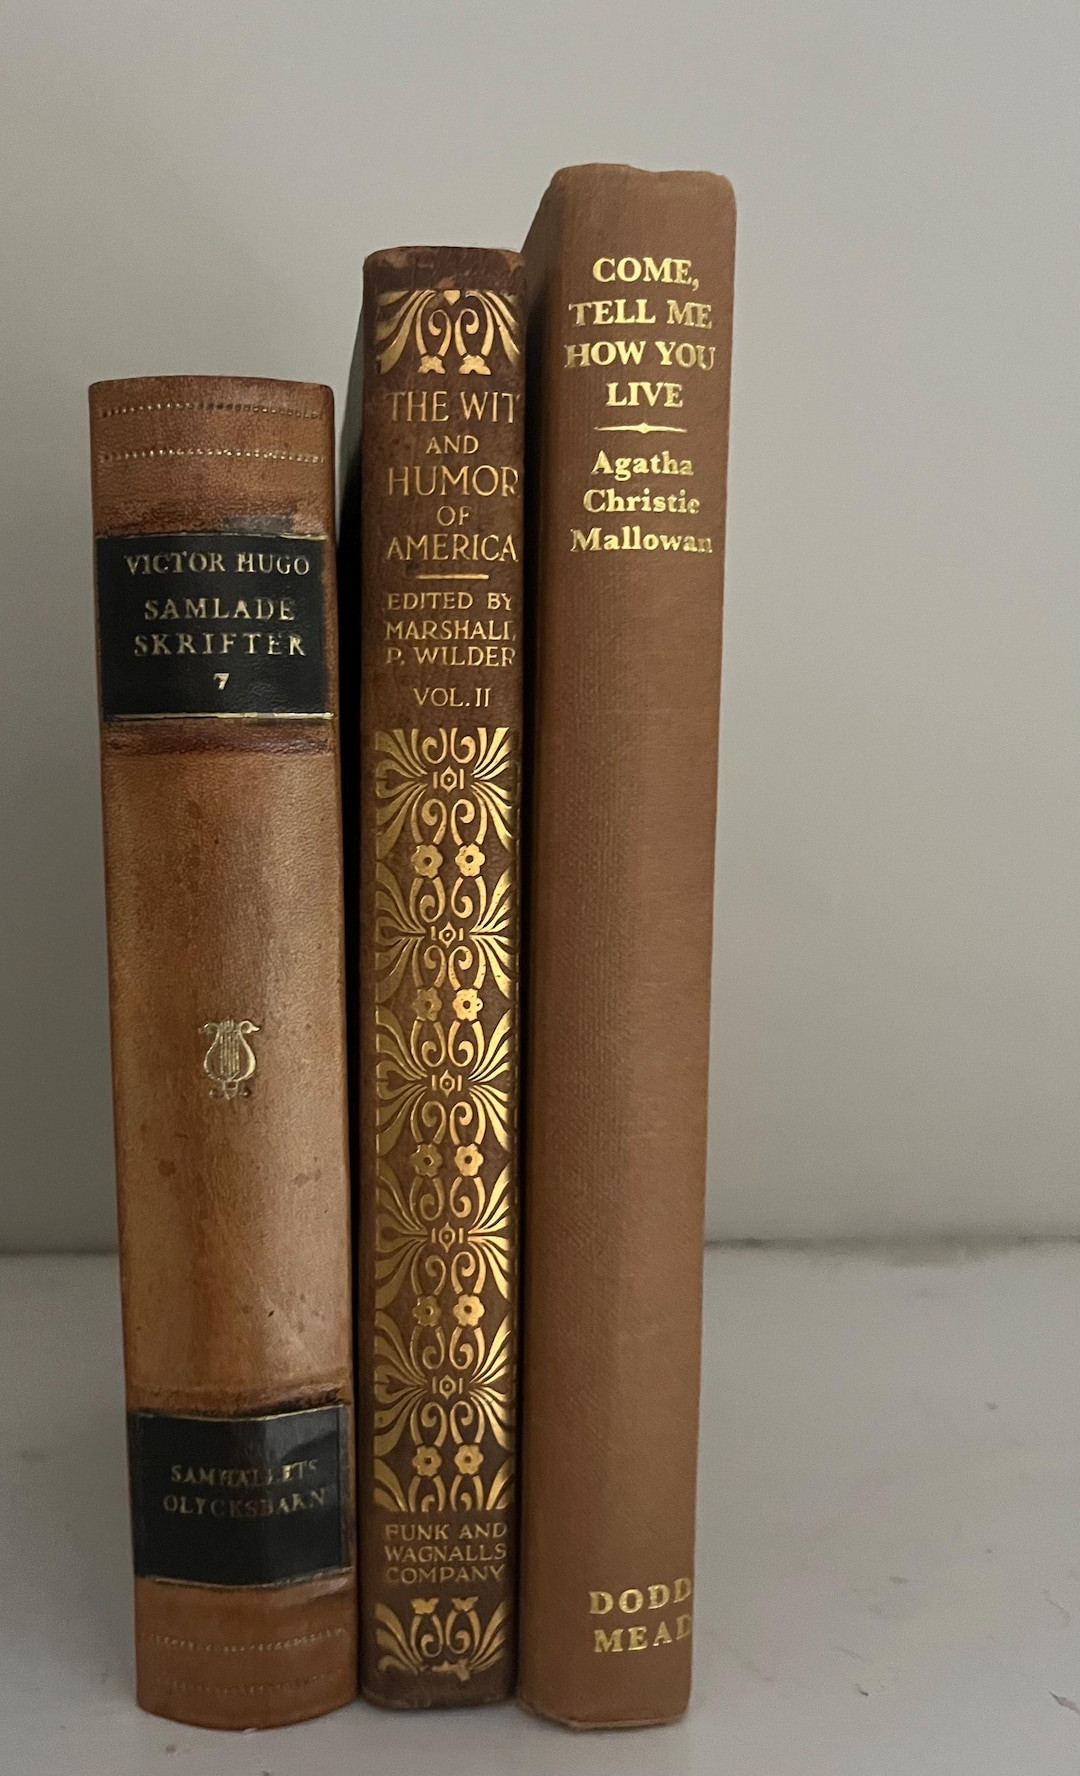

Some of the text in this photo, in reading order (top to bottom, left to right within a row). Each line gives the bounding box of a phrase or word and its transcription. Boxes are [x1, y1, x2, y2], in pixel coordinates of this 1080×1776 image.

[592, 257, 700, 291] COME,
[568, 298, 713, 329] TELL ME
[563, 340, 716, 371] HOW YOU
[388, 390, 521, 424] THE WIT
[605, 381, 684, 408] LIVE
[425, 434, 479, 454] AND
[591, 450, 694, 482] Agatha
[388, 464, 520, 497] HUMOR
[583, 487, 701, 514] Christie
[436, 505, 472, 527] OF
[386, 533, 519, 562] AMERICA
[570, 525, 713, 554] Mallowan
[124, 551, 311, 576] VICTOR HUGO
[144, 598, 296, 622] SAMLADE
[386, 591, 512, 611] EDITED BY
[384, 620, 517, 641] MARSHALL
[133, 632, 306, 657] SKRIFTER
[386, 646, 516, 667] P. WILDER
[213, 672, 231, 691] 7
[413, 686, 492, 708] VOL. II
[385, 1522, 508, 1542] FUNK AND
[384, 1543, 507, 1563] WAGNALLS
[385, 1563, 506, 1584] COMPANY
[588, 1577, 692, 1615] DODD
[593, 1613, 692, 1653] MEAD
